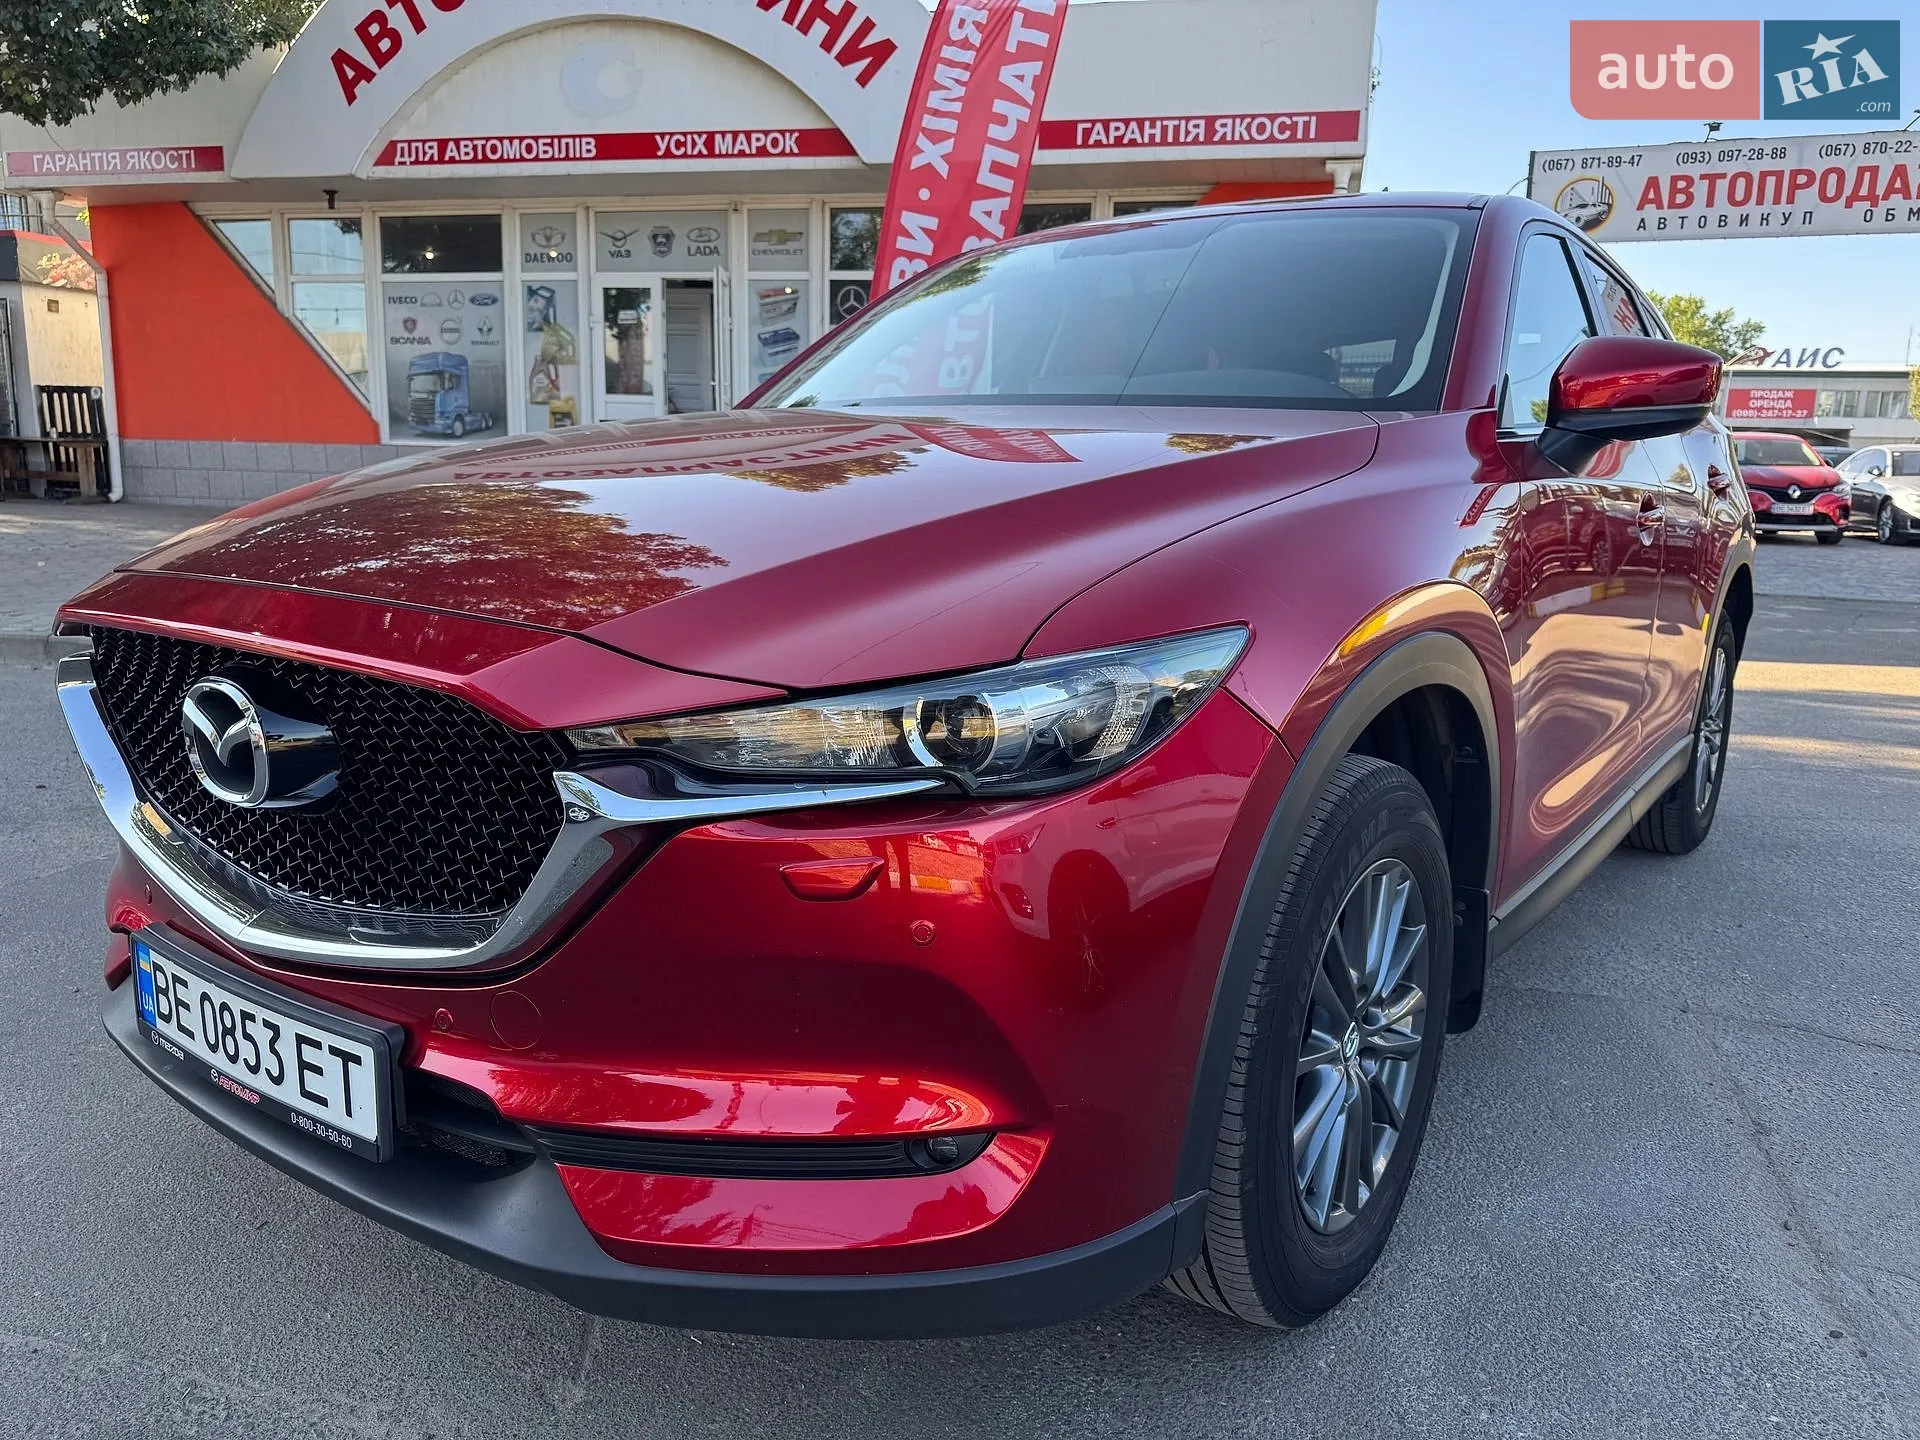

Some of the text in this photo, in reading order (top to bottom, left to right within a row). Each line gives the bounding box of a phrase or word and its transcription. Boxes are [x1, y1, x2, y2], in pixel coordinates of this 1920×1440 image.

[911, 4, 989, 180] ХІМІЯ
[1076, 116, 1317, 146] ГАРАНТІЯ ЯКОСТІ
[394, 132, 800, 166] ДЛЯ АВТОМОБІЛІВ УСІХ МАРОК
[1542, 140, 1920, 173] (067) 871-89-47 (093) 097-28-88 (067) 870-22-
[33, 149, 196, 173] ГАРАНТІЯ ЯКОСТІ
[1636, 164, 1920, 211] АВТОПРОДА
[1637, 211, 1813, 231] АВТОВИКУП
[525, 253, 573, 264] DAEWOO
[688, 246, 721, 256] LADA
[388, 296, 418, 304] IVECO
[390, 336, 432, 345] SCANIA
[1771, 347, 1845, 368] АИС
[1749, 399, 1792, 409] ОРЕНДА
[1750, 390, 1794, 399] ПРОДАЖ
[142, 992, 154, 1015] UA
[152, 959, 362, 1119] BE 0853 ET
[290, 1112, 353, 1149] 0-800-30-50-60
